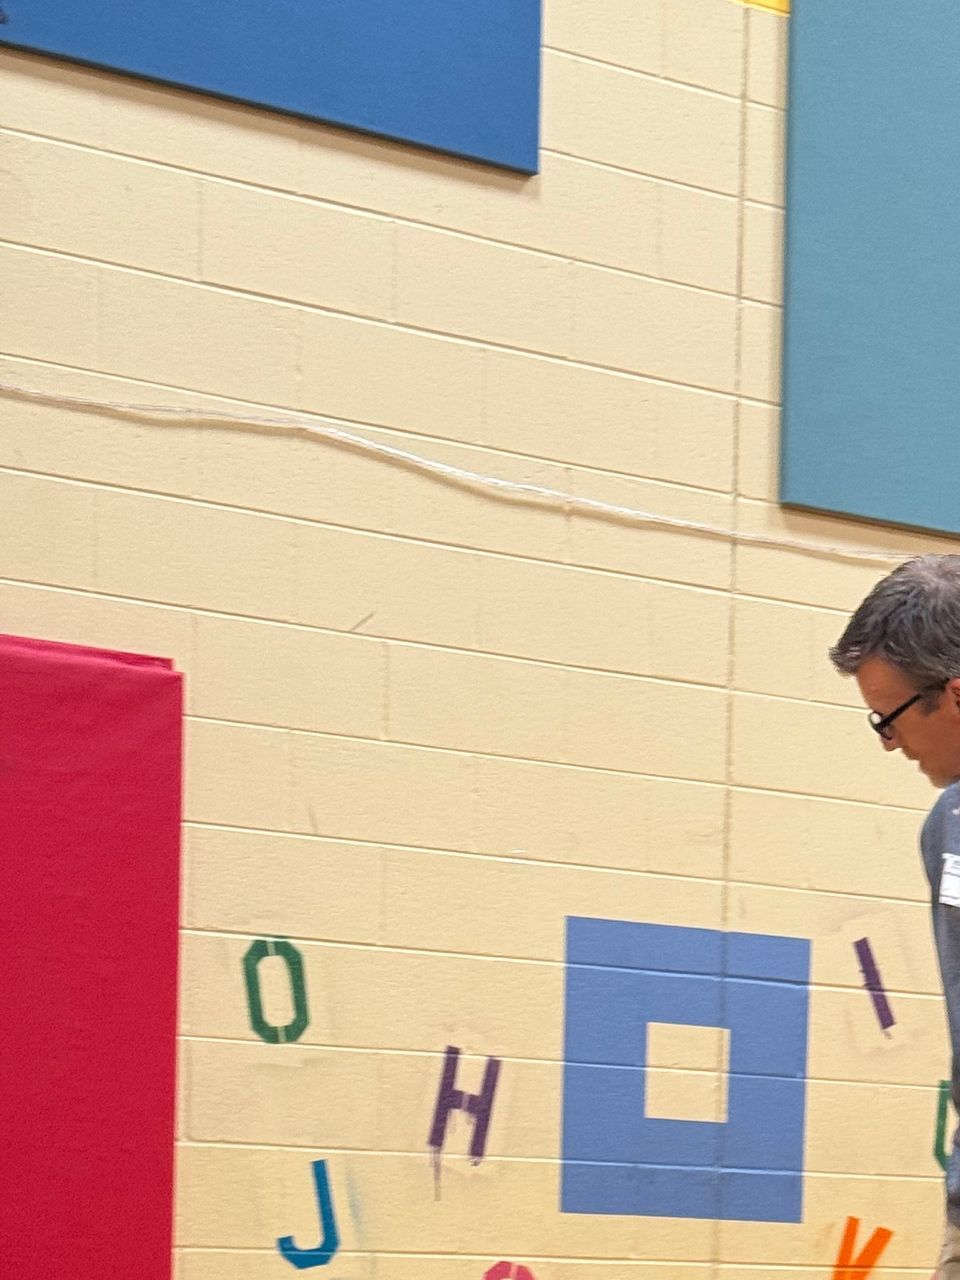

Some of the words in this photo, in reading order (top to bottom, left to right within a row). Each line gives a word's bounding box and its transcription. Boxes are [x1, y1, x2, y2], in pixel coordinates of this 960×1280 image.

[241, 937, 310, 1044] O
[428, 1045, 502, 1160] H
[276, 1159, 341, 1270] J
